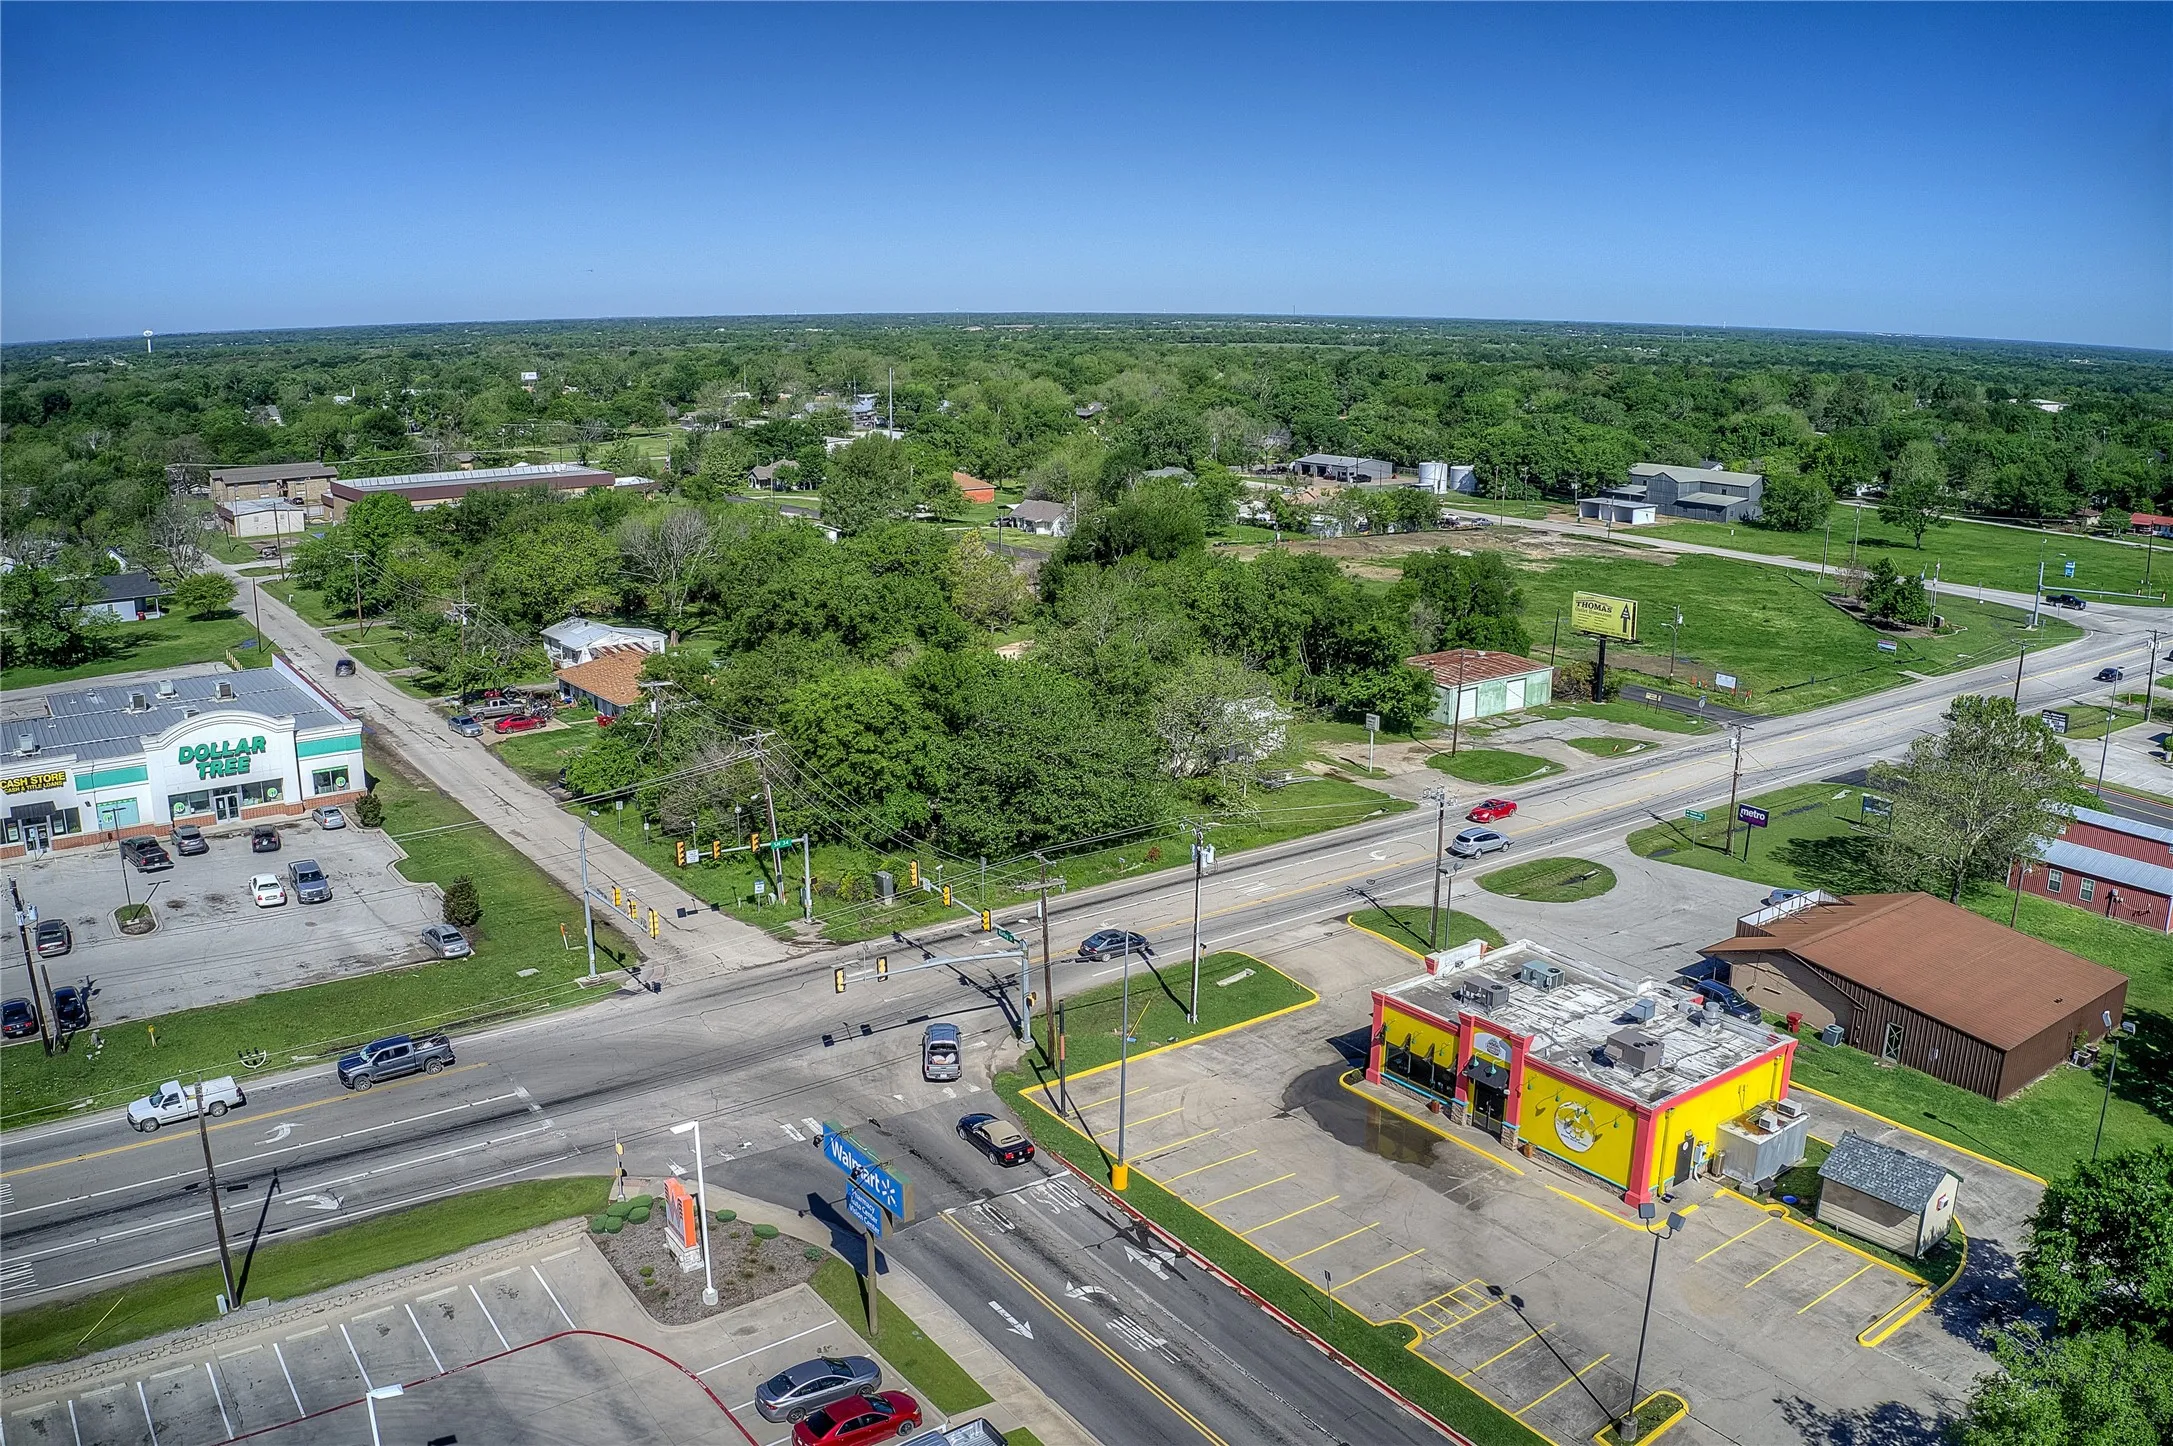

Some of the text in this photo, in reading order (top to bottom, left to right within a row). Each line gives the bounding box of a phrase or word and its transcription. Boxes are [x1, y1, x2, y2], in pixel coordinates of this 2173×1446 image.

[1576, 601, 1612, 613] THOMAS
[178, 736, 267, 765] DOLLAR
[195, 755, 251, 780] TREE
[0, 772, 66, 789] CASH STORE
[1740, 808, 1765, 820] metro
[830, 1137, 880, 1193] Walmart
[1027, 1180, 1085, 1214] STOP
[862, 1206, 877, 1224] Center
[864, 1216, 880, 1234] Center
